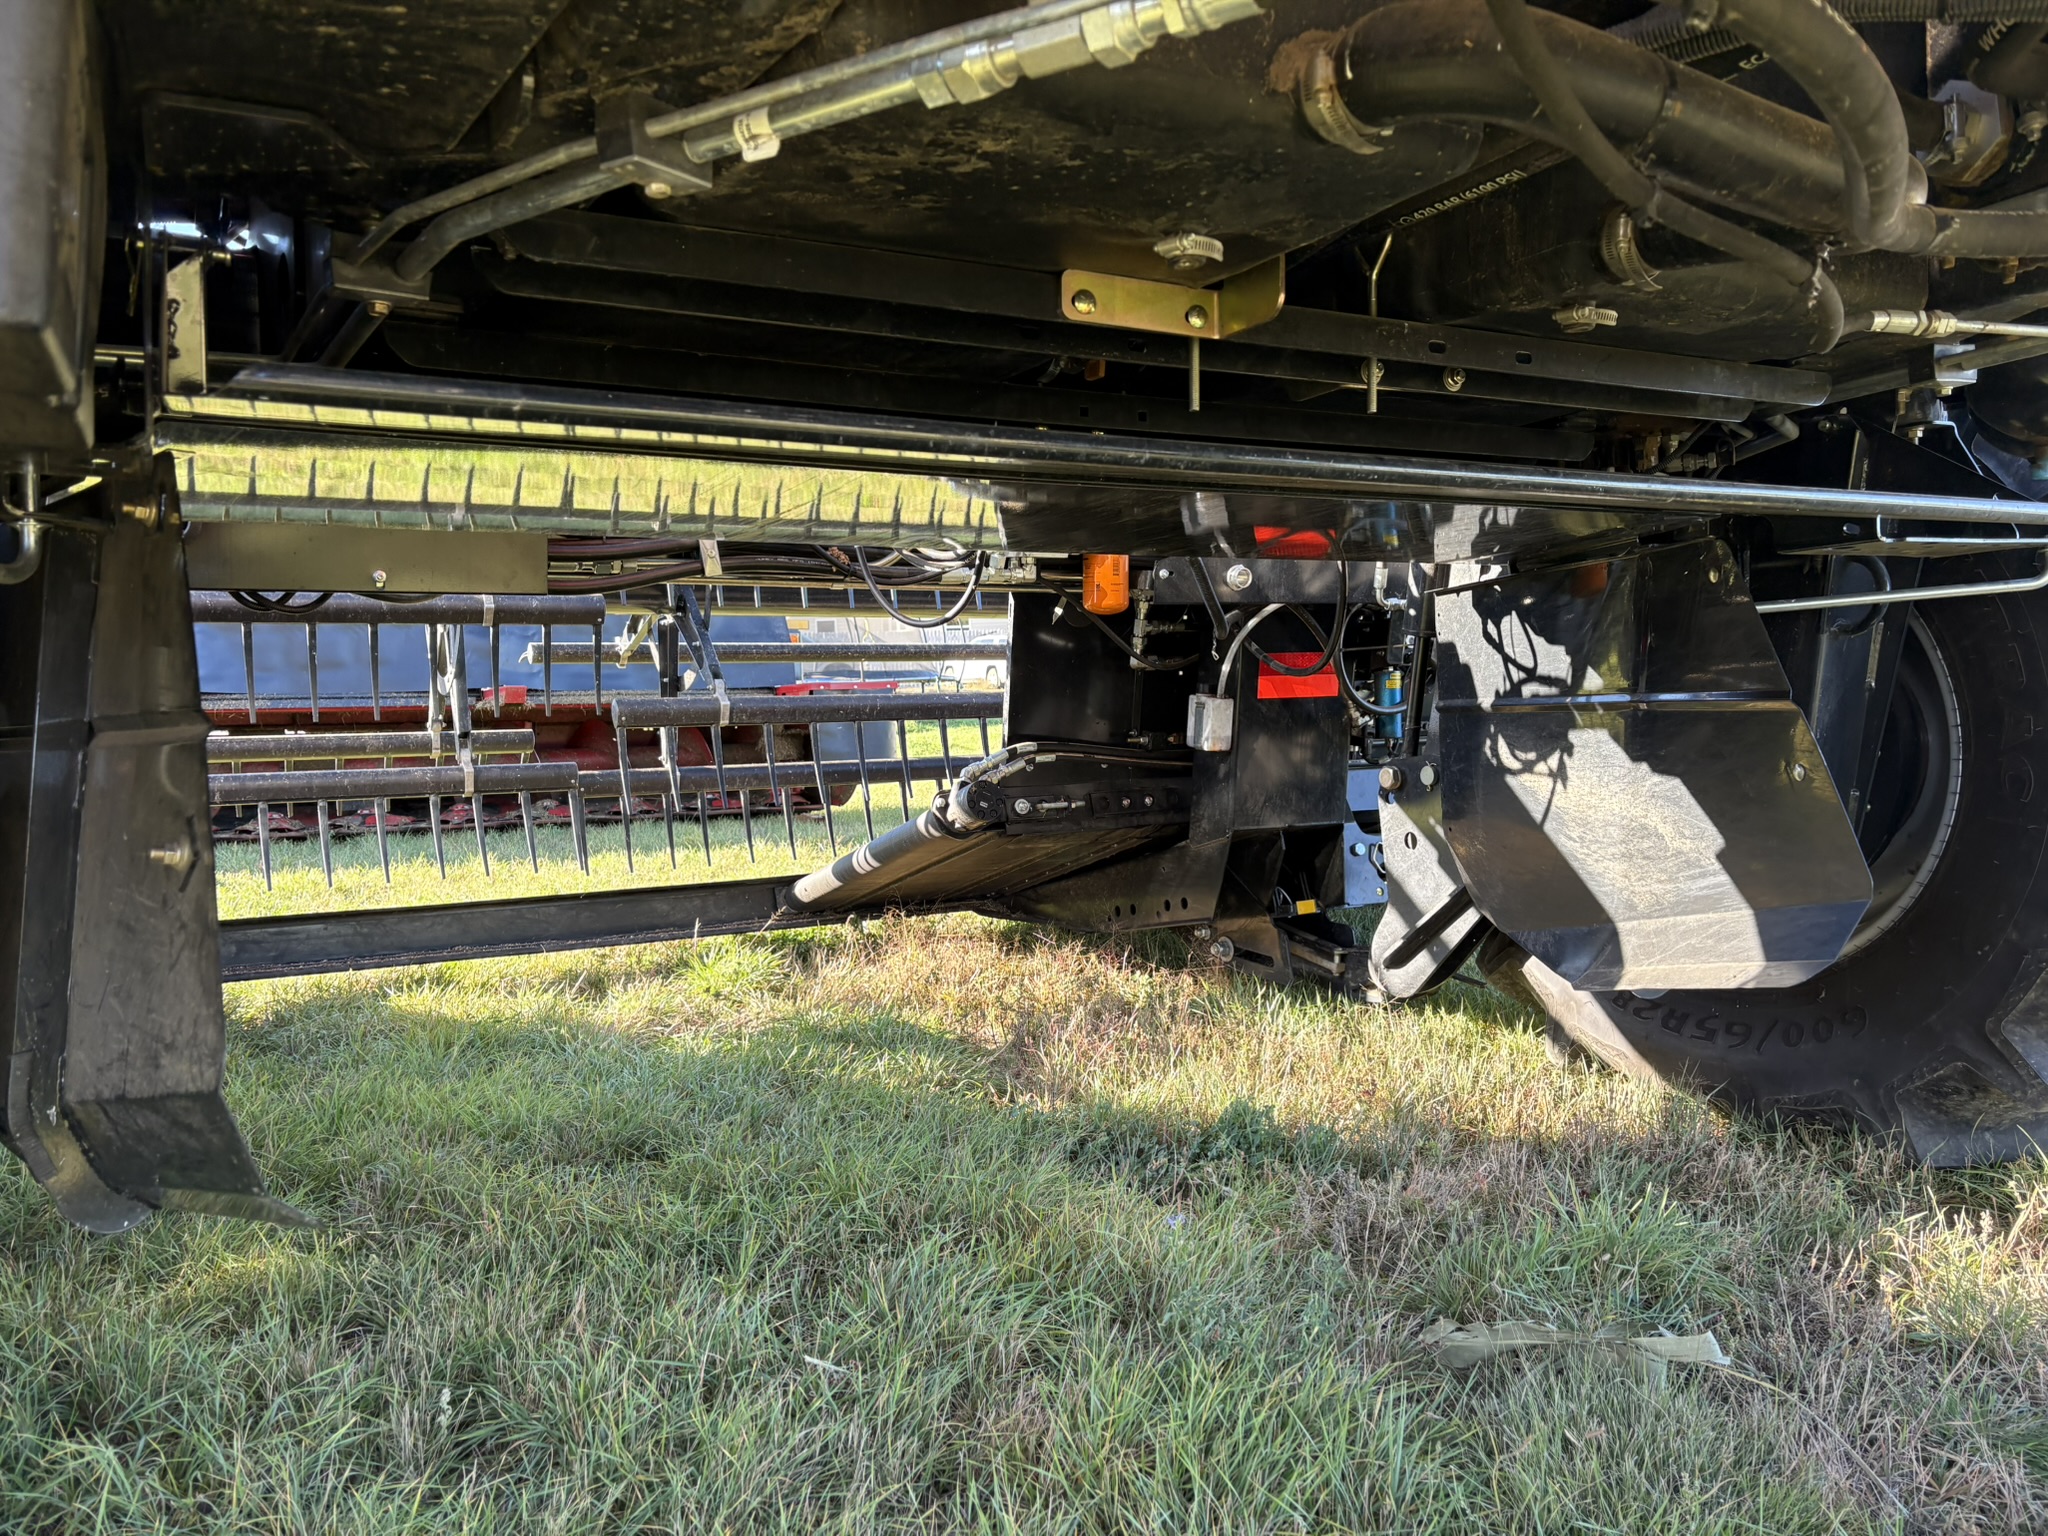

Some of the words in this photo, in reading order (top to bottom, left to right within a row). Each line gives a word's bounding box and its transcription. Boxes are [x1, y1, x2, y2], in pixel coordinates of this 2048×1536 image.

[1436, 195, 1460, 211] BAR
[1460, 181, 1497, 202] (6100
[1496, 169, 1528, 184] PSI)
[1611, 990, 1869, 1055] 600/65R28
